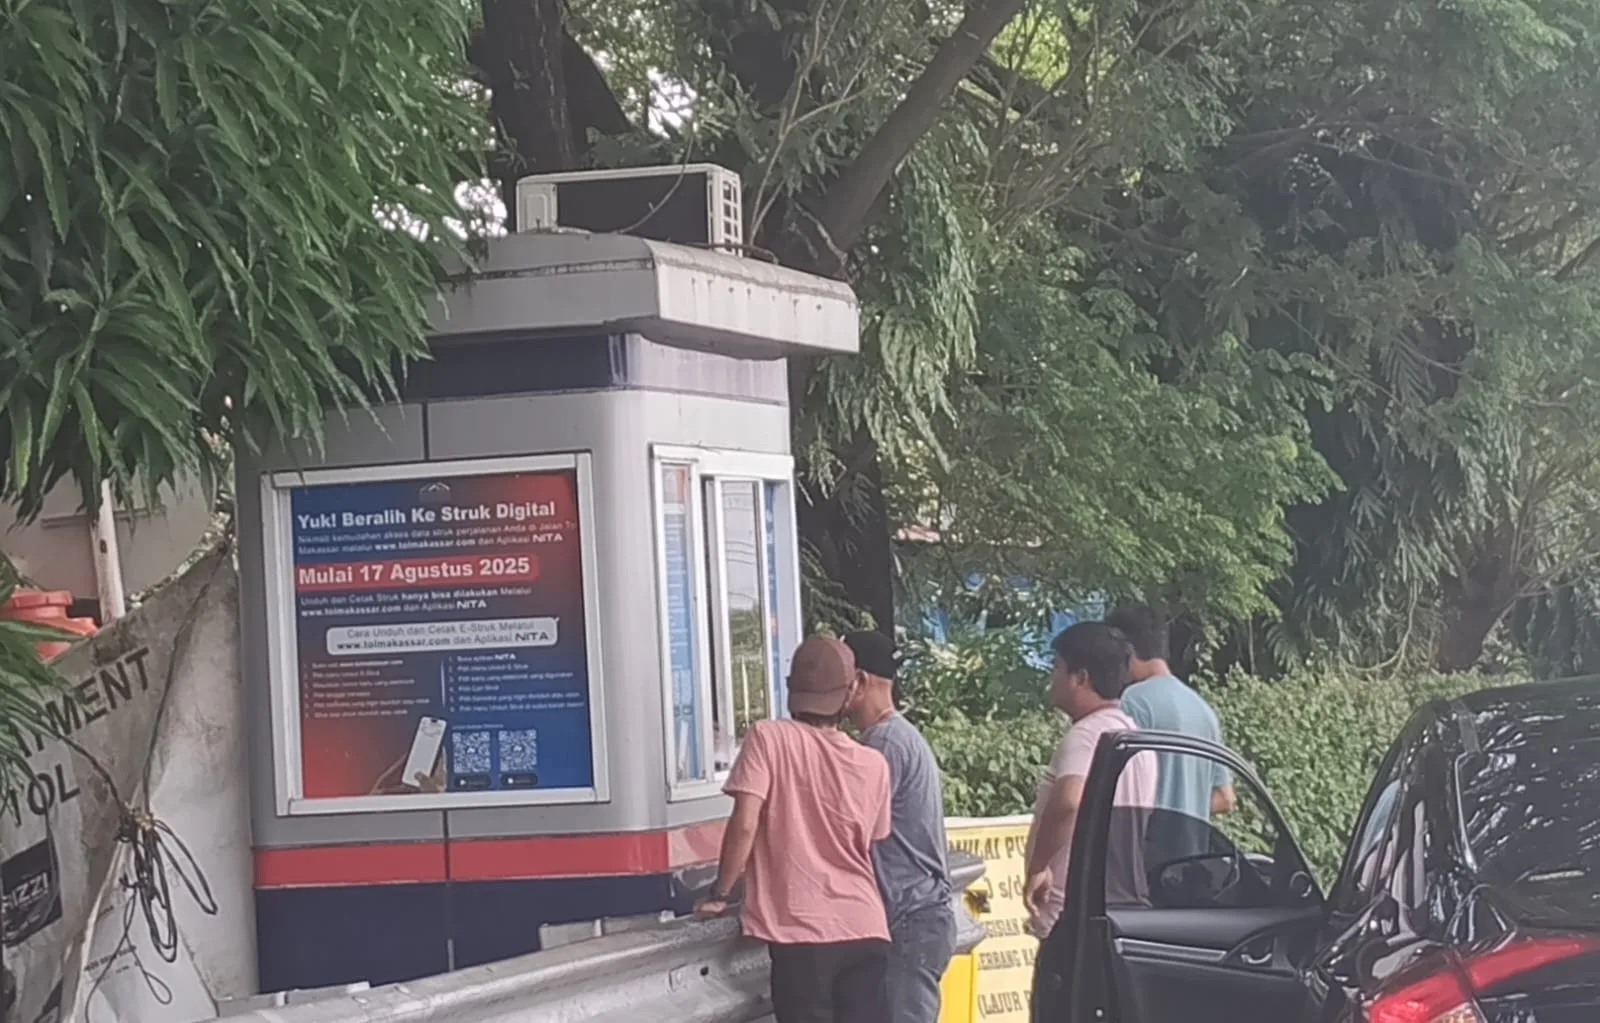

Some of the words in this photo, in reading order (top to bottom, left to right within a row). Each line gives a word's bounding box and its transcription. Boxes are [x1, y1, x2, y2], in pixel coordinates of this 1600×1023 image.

[297, 511, 337, 529] Yuk!
[342, 508, 406, 527] Beralih
[411, 506, 436, 523] Ke
[441, 504, 491, 521] Struk
[496, 501, 555, 521] Digital
[532, 533, 563, 543] NITA
[299, 565, 353, 585] Mulai
[360, 564, 384, 581] 17
[390, 562, 473, 583] Agustus
[480, 557, 530, 576] 2025
[401, 591, 429, 602] hanya
[431, 590, 451, 599] bisa
[453, 588, 498, 599] dilakukan
[456, 599, 487, 609] NITA
[515, 631, 549, 641] NITA
[977, 949, 1021, 970] ERBANG
